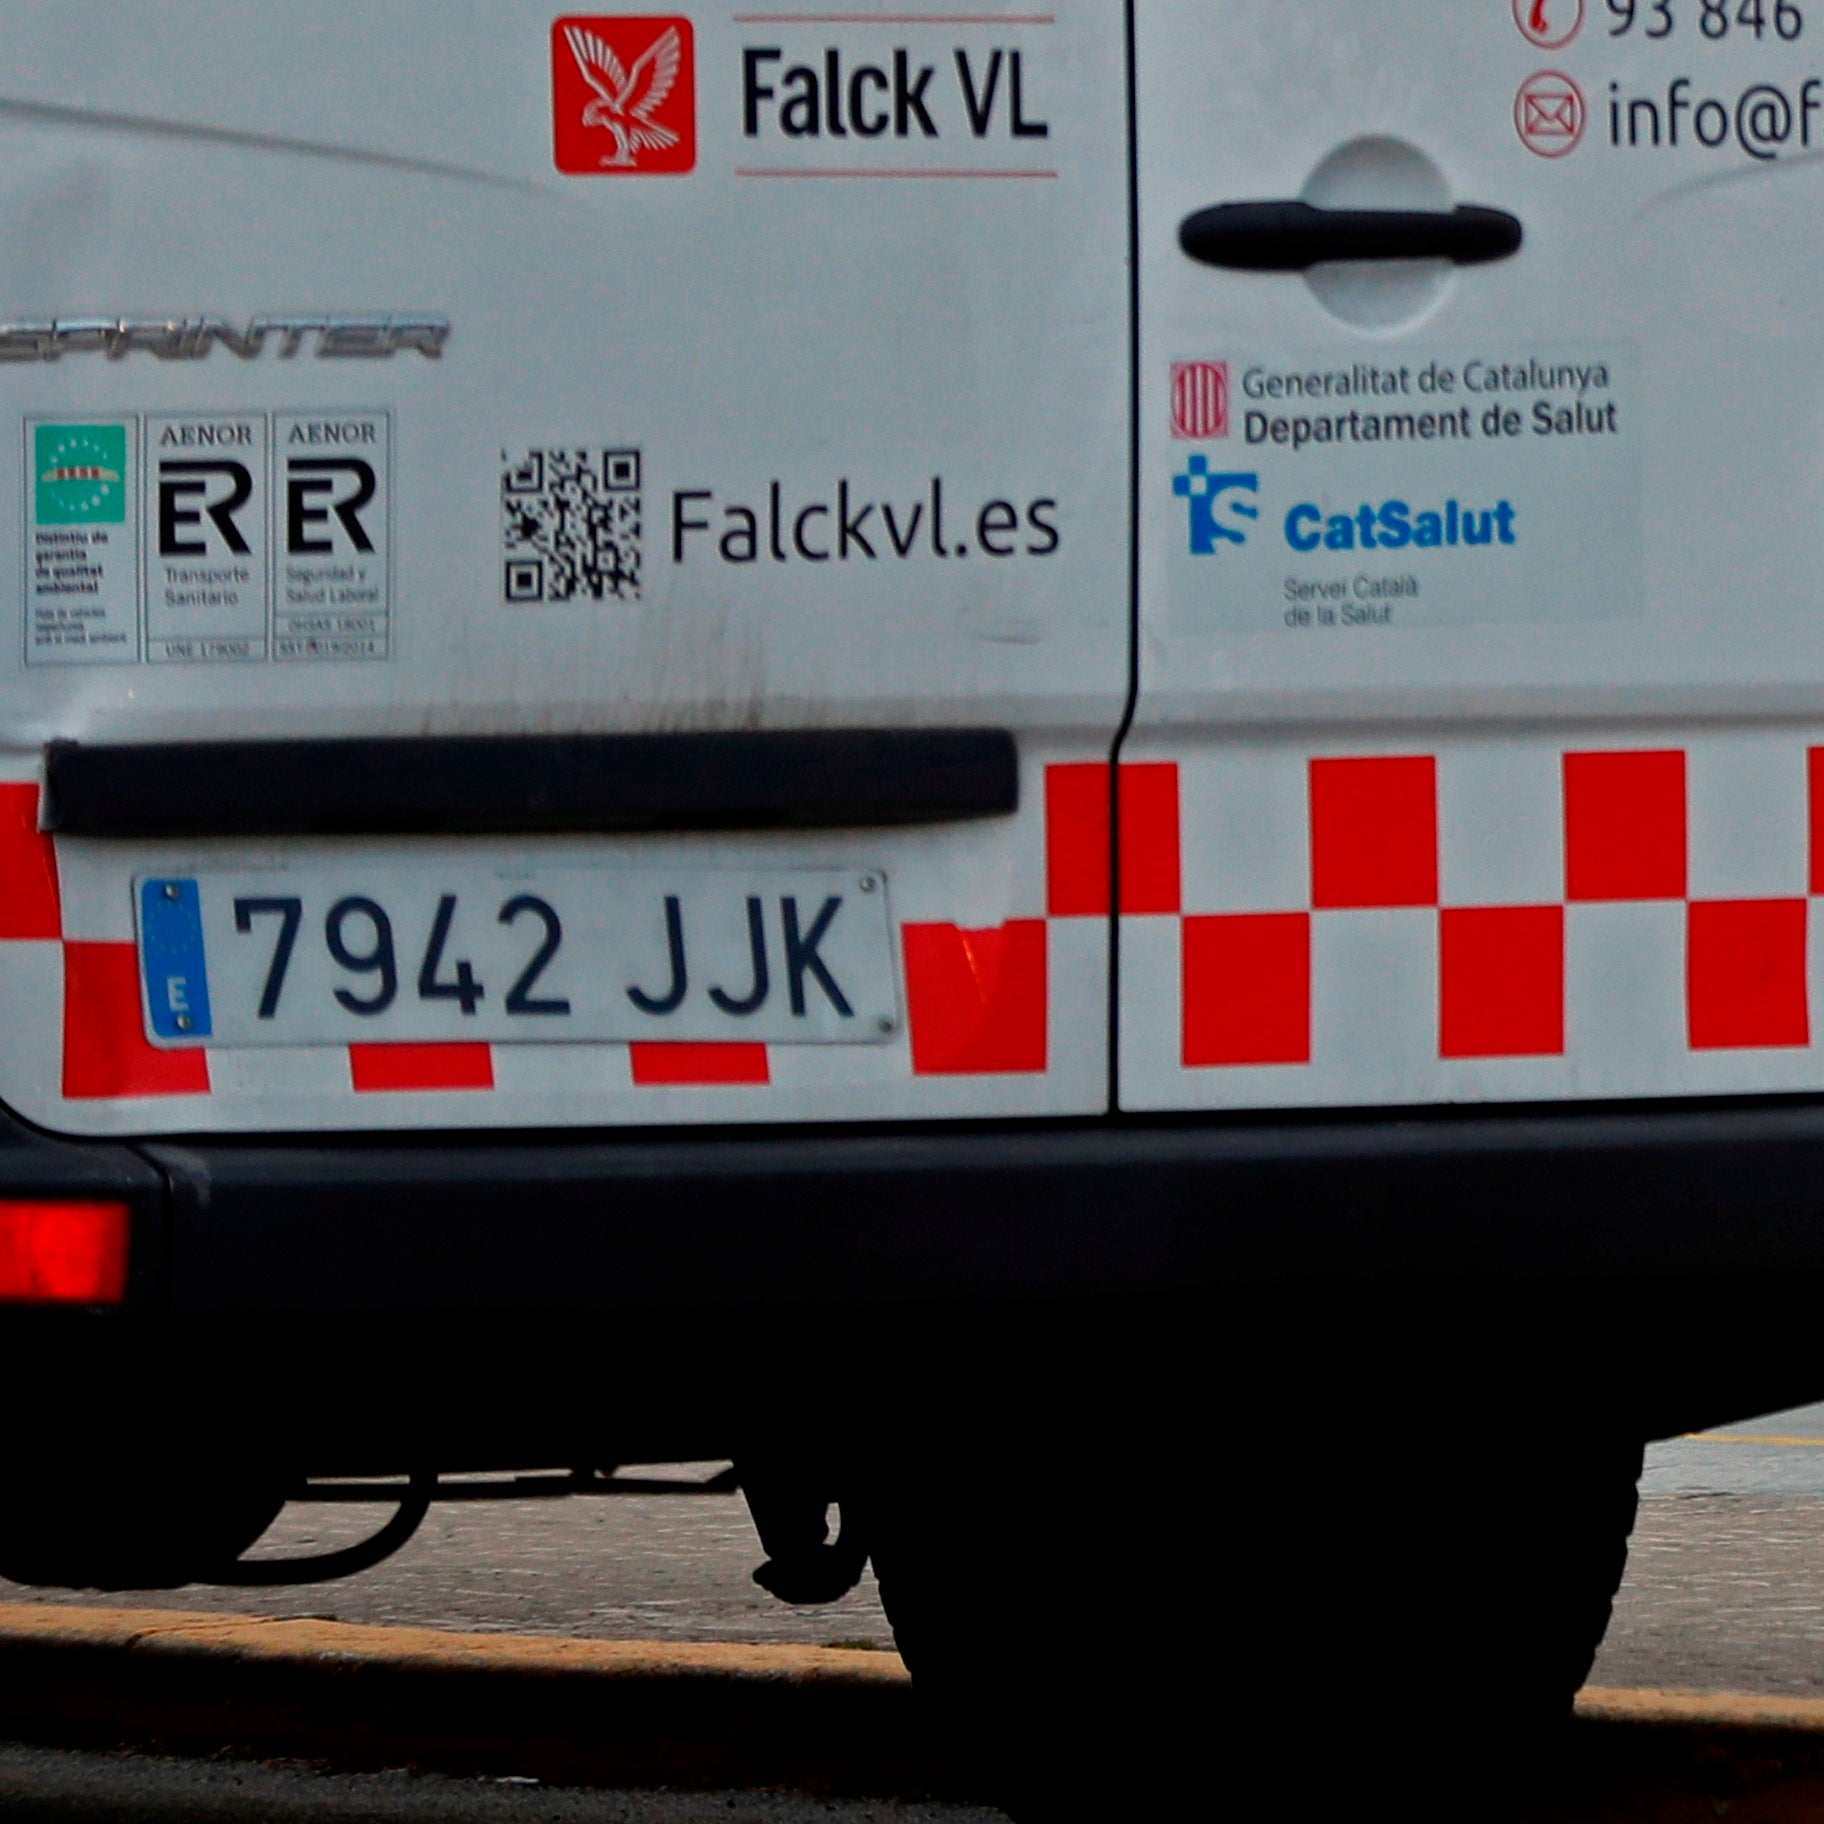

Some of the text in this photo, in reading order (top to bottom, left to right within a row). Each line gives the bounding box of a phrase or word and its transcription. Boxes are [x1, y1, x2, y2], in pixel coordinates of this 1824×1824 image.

[741, 47, 1049, 139] Falck VL
[1242, 358, 1610, 400] Generalitat de Catalunya
[160, 424, 253, 447] AENOR
[288, 422, 377, 445] AENOR
[1243, 400, 1618, 450] Departament de Salut
[671, 476, 1060, 563] Falckvl.es
[1283, 498, 1515, 553] CatSalut
[164, 588, 239, 607] Sanitario
[1283, 575, 1419, 602] Servei Català
[1283, 603, 1391, 627] de la Salut
[233, 894, 856, 1018] 7942 JJK
[167, 979, 189, 1013] E
